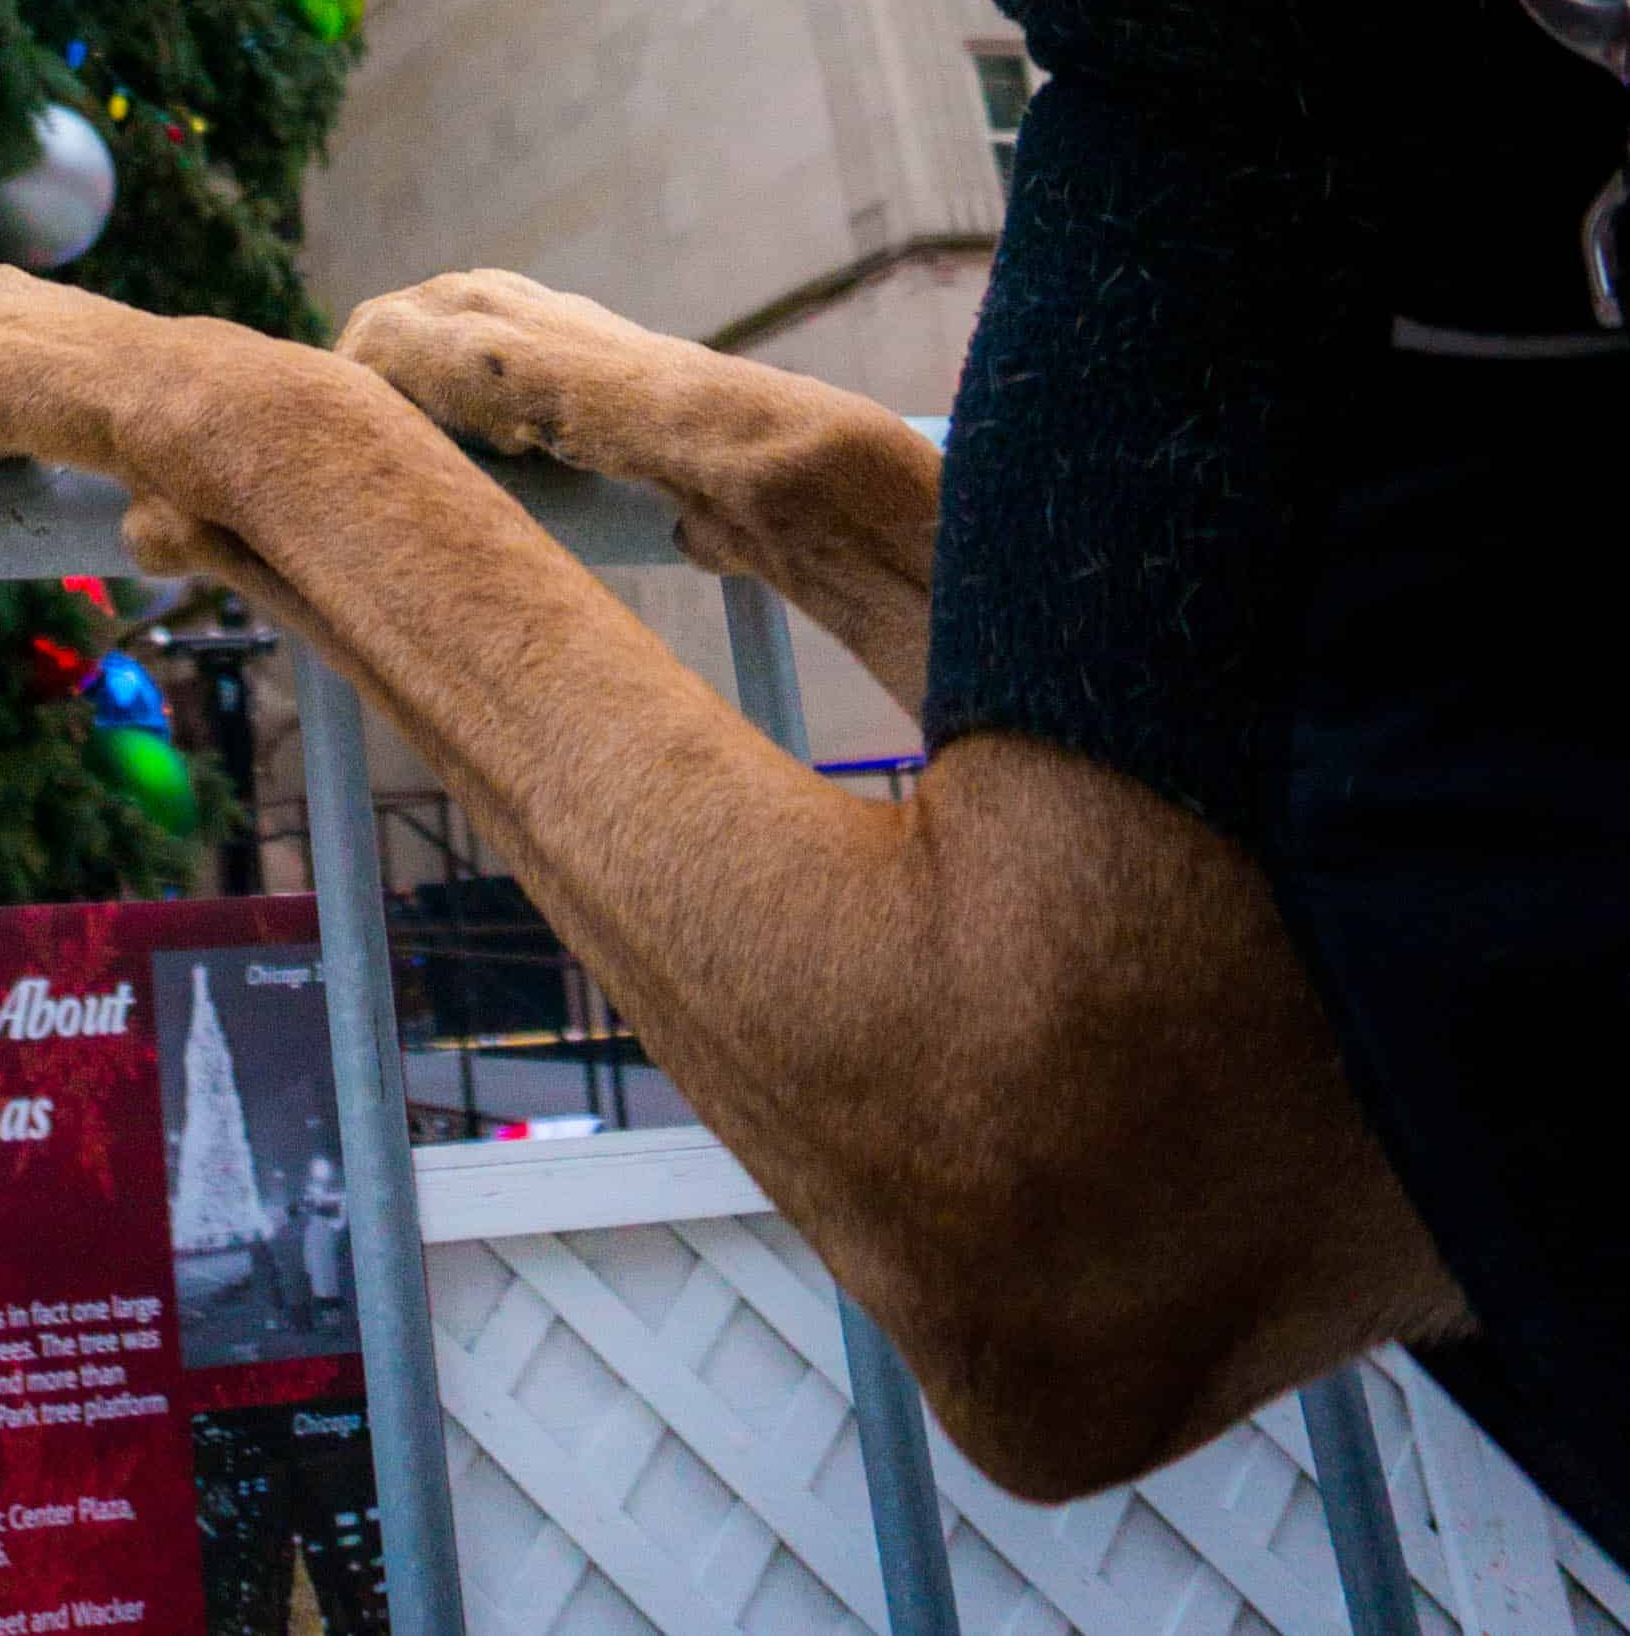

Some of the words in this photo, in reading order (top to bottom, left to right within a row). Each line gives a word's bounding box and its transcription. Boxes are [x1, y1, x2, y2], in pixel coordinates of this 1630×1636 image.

[7, 1302, 29, 1328] in
[30, 1299, 70, 1326] fact
[71, 1300, 110, 1323] one
[111, 1294, 163, 1324] large
[38, 1331, 77, 1358] The
[78, 1332, 120, 1355] tree
[120, 1329, 162, 1351] was
[26, 1369, 79, 1393] more
[79, 1362, 127, 1389] than
[40, 1402, 83, 1425] tree
[83, 1392, 170, 1428] platform
[8, 1502, 76, 1531] Center
[30, 1601, 70, 1634] and
[70, 1595, 146, 1628] Wacker
